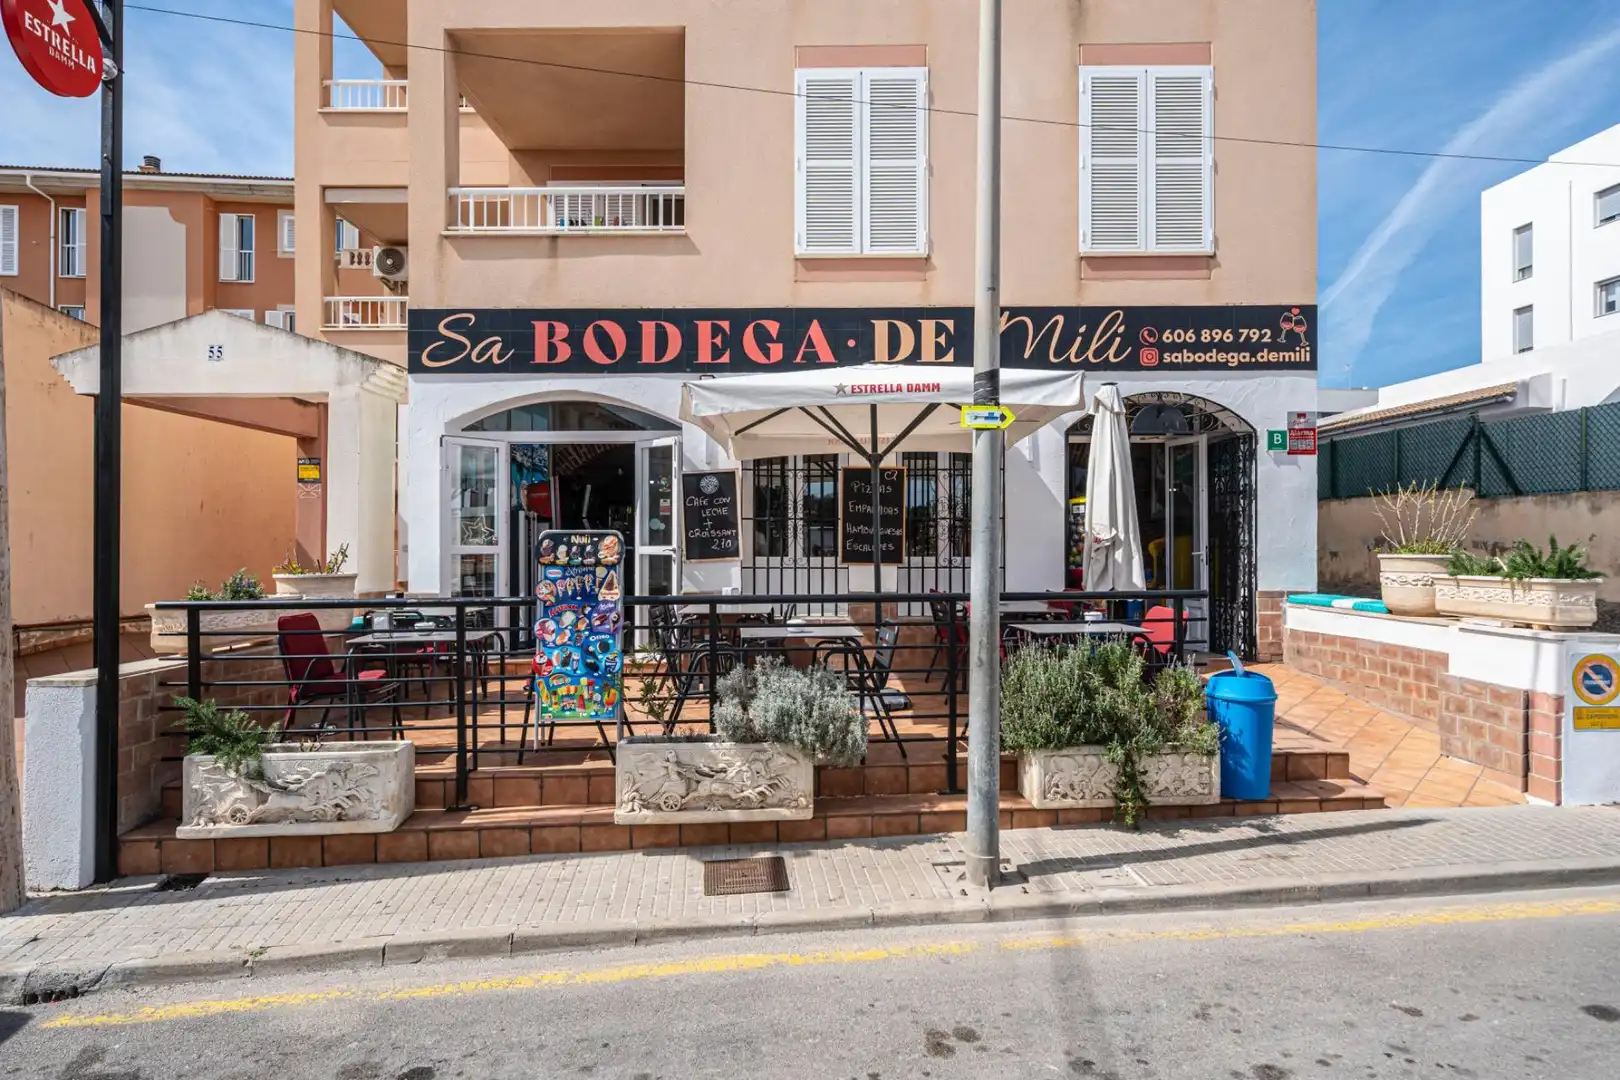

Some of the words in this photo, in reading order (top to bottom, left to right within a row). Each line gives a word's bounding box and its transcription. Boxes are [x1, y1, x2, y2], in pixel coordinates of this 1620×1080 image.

[24, 11, 96, 74] ESTRELLA
[48, 46, 75, 70] DAMM
[421, 312, 514, 367] Sa
[529, 319, 838, 364] BODEGA
[870, 318, 955, 363] DE
[1162, 328, 1196, 343] 606
[1200, 328, 1234, 343] 896
[1238, 328, 1272, 343] 792
[208, 346, 223, 359] 55
[1162, 347, 1311, 367] sabodega.demili
[851, 383, 903, 394] ESTRELLA
[906, 382, 941, 393] DAMM
[1273, 433, 1282, 444] B
